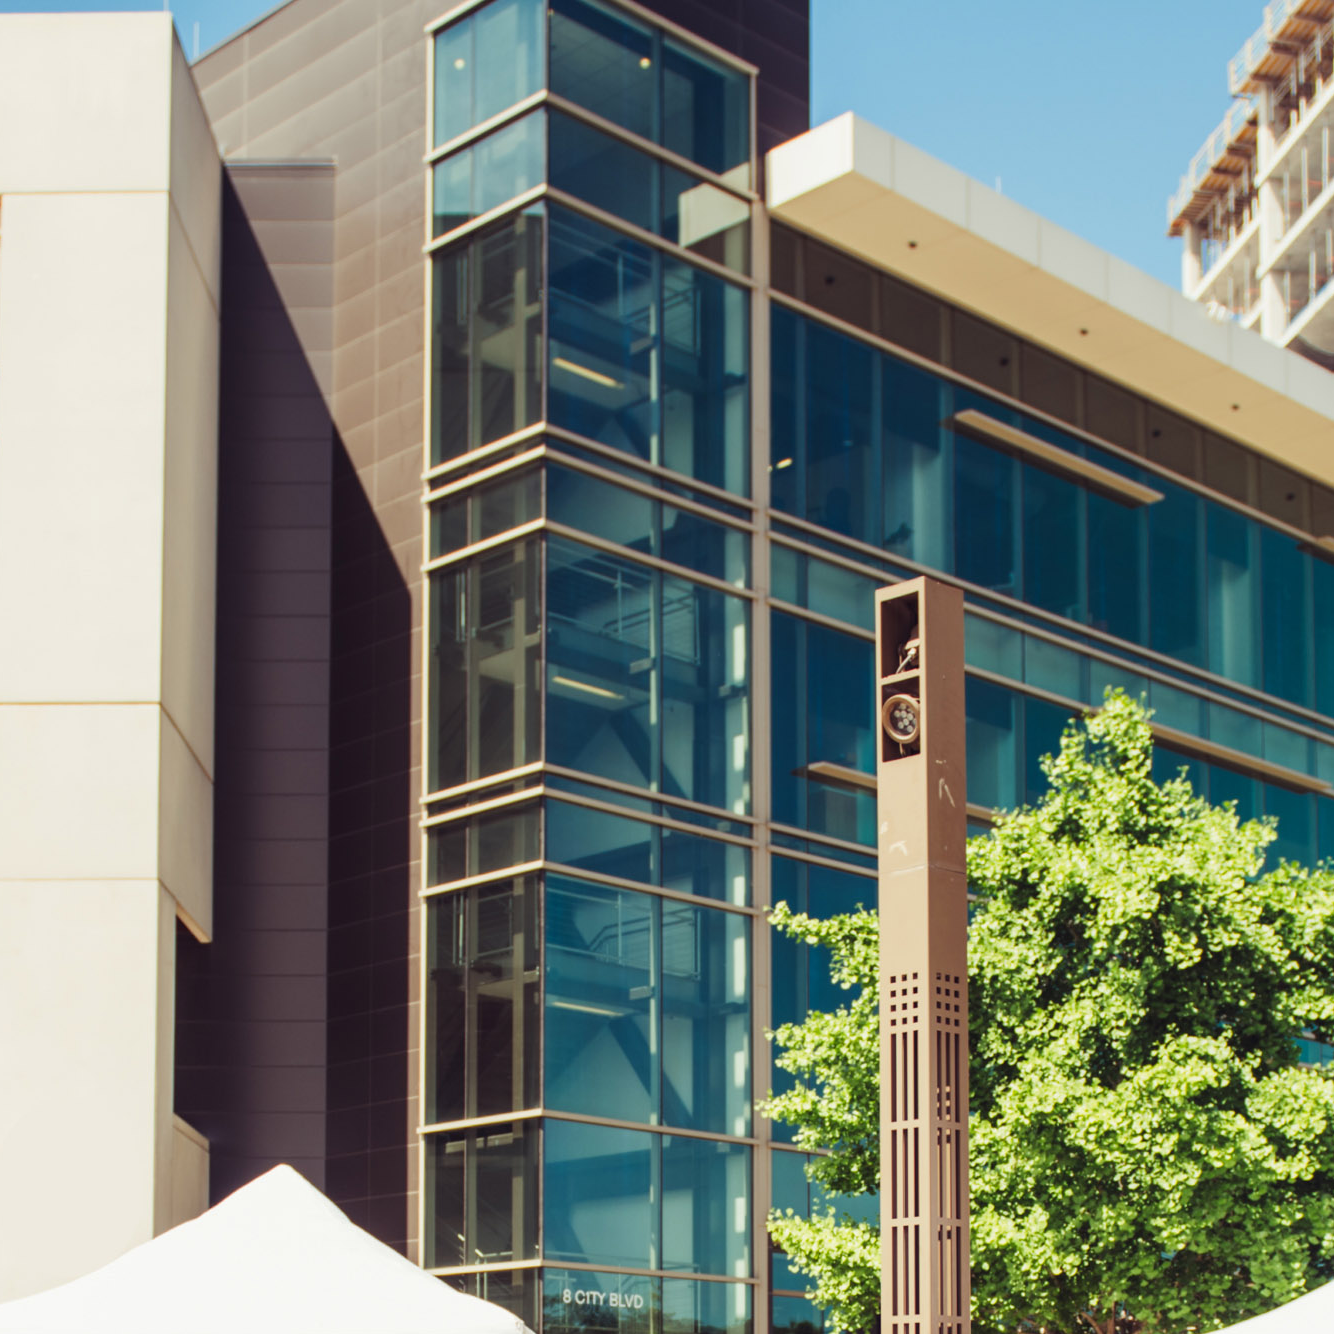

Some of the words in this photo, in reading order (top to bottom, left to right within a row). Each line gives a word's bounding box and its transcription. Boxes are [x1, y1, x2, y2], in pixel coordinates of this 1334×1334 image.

[562, 1288, 572, 1304] 8
[575, 1289, 606, 1307] CITY
[609, 1292, 644, 1309] BLVD
